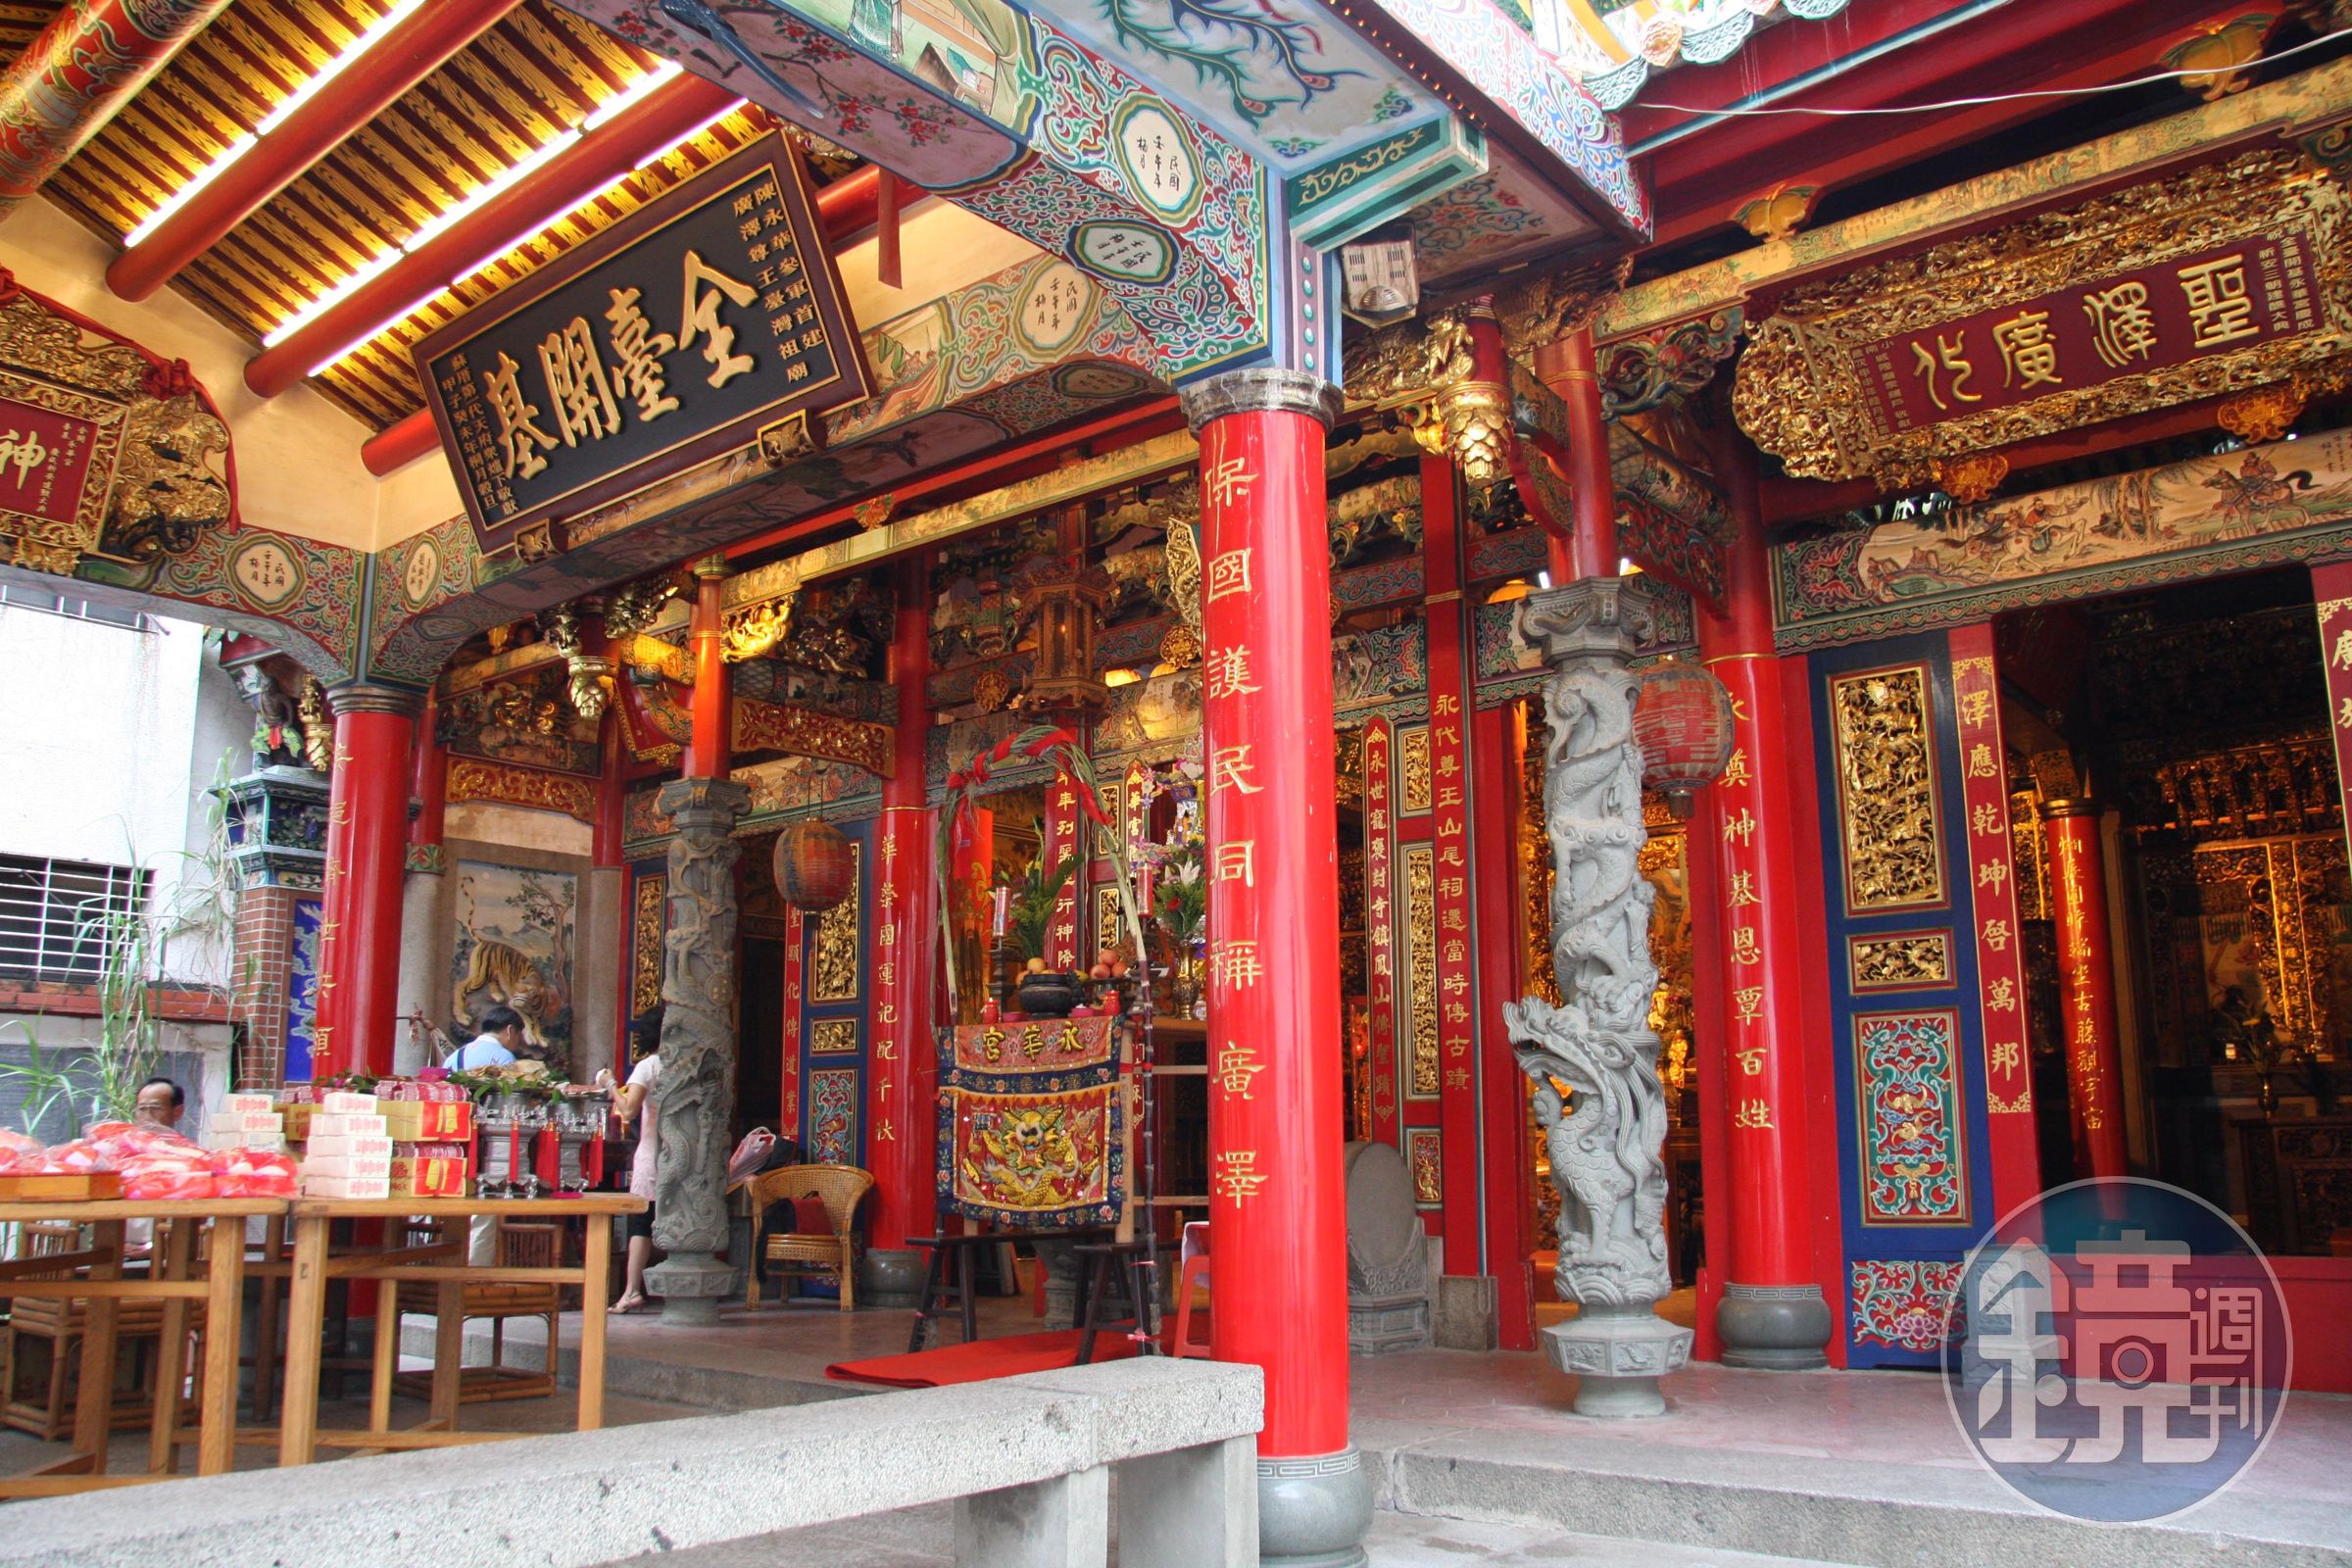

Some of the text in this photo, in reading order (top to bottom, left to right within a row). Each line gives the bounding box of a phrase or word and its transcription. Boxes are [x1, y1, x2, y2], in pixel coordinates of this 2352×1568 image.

[483, 249, 759, 480] 全臺開基
[1204, 457, 1269, 1208] 保國護民同稱廣澤
[982, 1020, 1083, 1062] 永華宮
